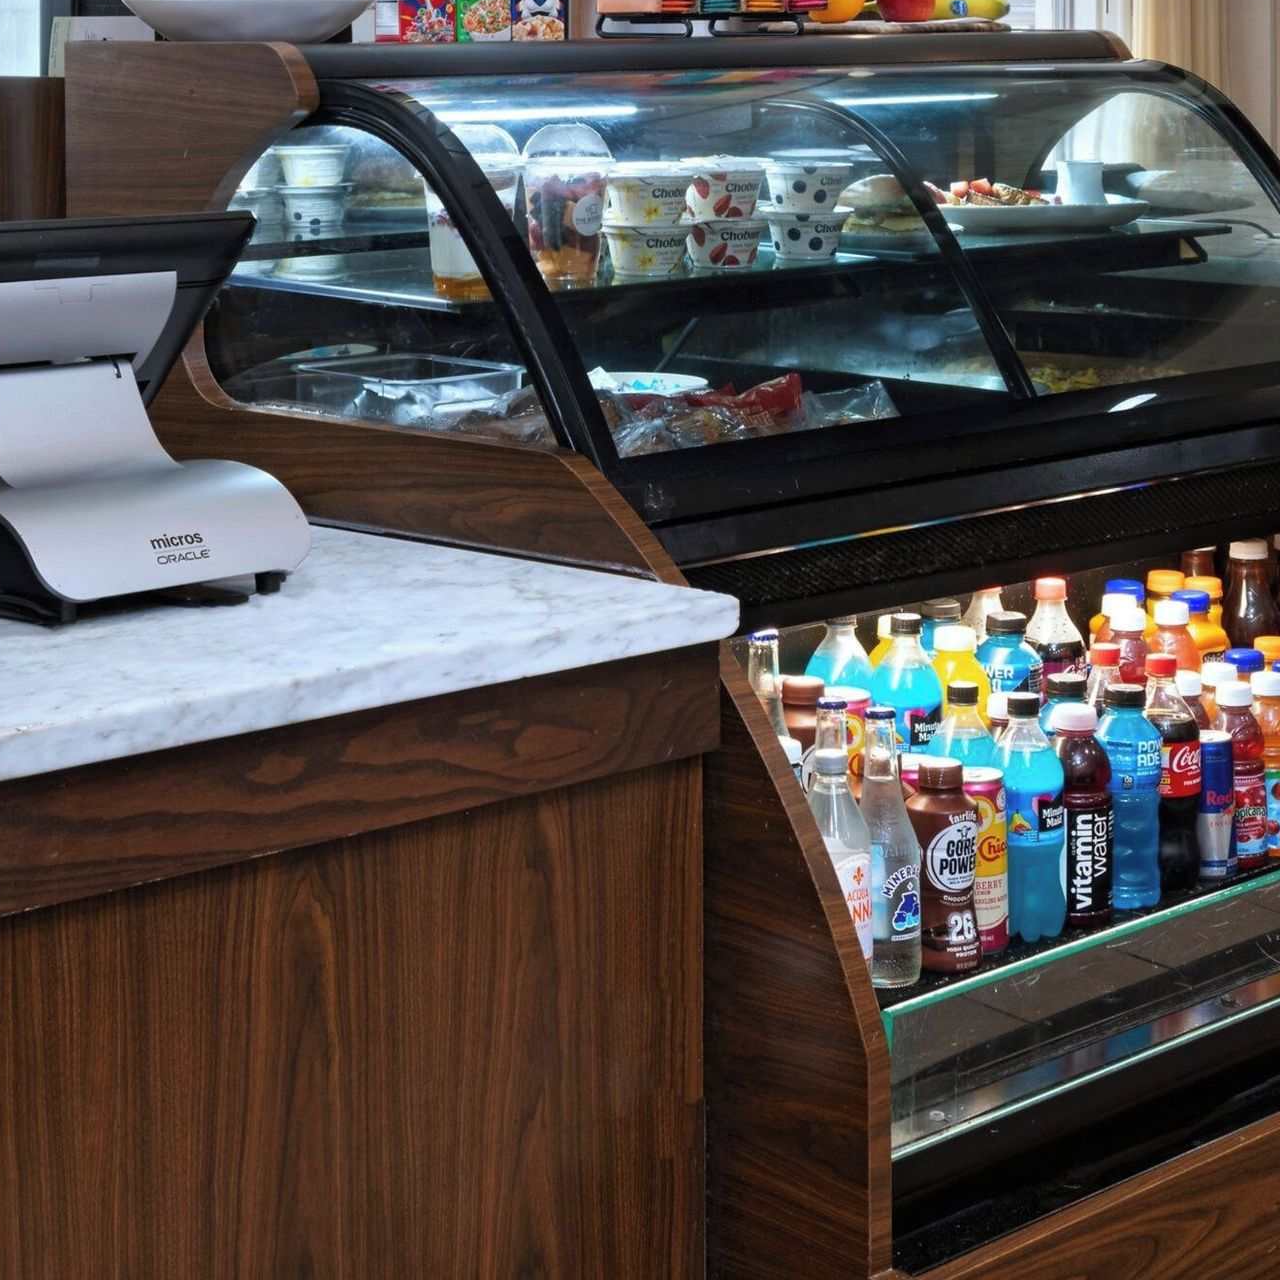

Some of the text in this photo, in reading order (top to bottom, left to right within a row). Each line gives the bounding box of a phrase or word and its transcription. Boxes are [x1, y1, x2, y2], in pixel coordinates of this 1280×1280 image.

[150, 532, 203, 550] micros
[156, 549, 210, 565] ORACLE
[949, 810, 977, 824] fairlife
[946, 836, 976, 858] CORE
[1094, 813, 1108, 877] water
[1071, 814, 1093, 910] vitamin
